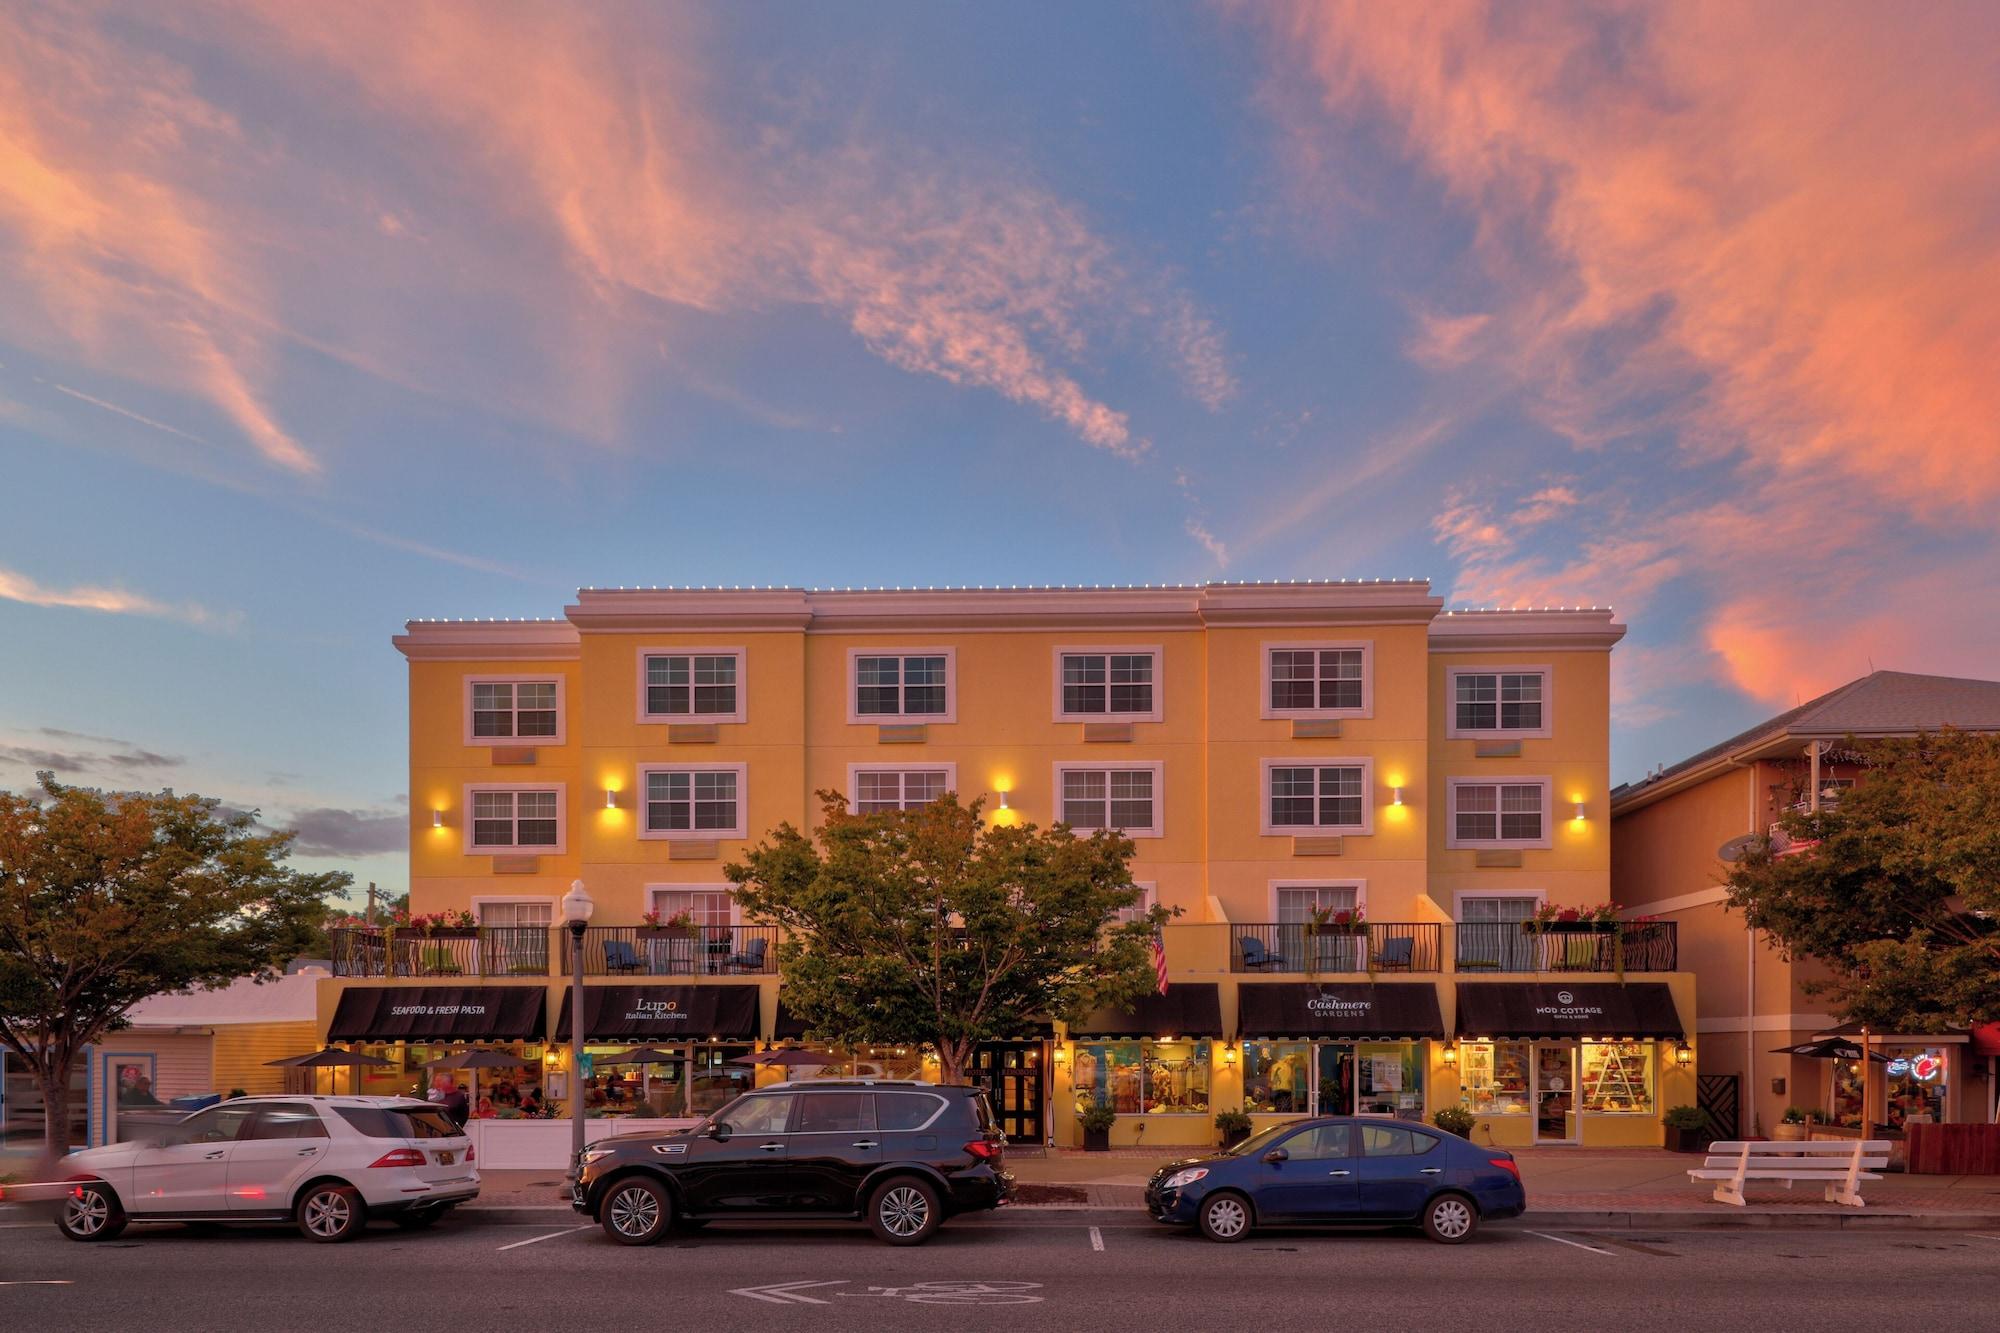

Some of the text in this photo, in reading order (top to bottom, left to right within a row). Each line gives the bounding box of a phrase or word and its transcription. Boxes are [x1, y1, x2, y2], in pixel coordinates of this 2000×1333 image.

[636, 998, 677, 1012] Lupo
[1307, 999, 1372, 1009] Cashmere
[391, 1006, 485, 1015] SEAFOOD & FRESH PASTA
[625, 1012, 688, 1020] Italian Kitchen
